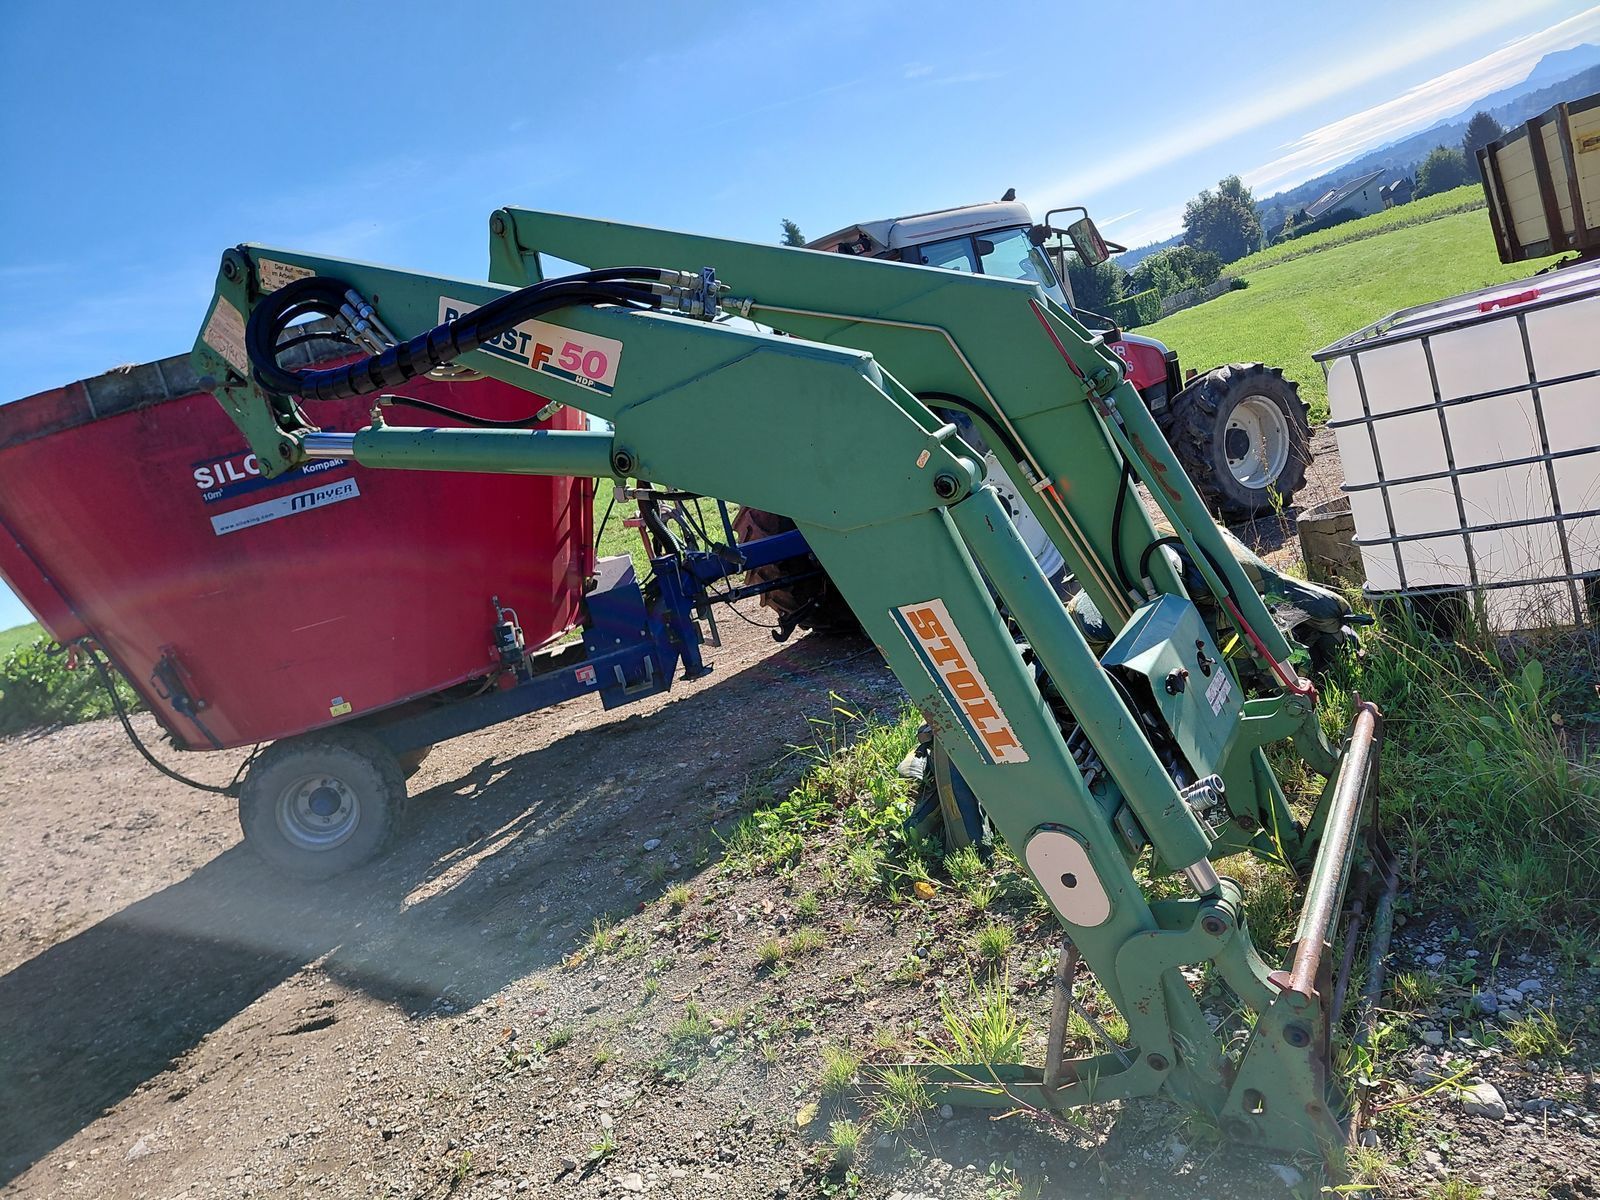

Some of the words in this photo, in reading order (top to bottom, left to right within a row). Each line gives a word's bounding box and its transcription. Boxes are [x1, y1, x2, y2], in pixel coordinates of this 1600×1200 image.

[531, 342, 553, 369] F
[558, 341, 607, 379] 50
[302, 459, 344, 474] Kompakt
[291, 484, 352, 510] MAYER
[906, 607, 1018, 757] STOLL
